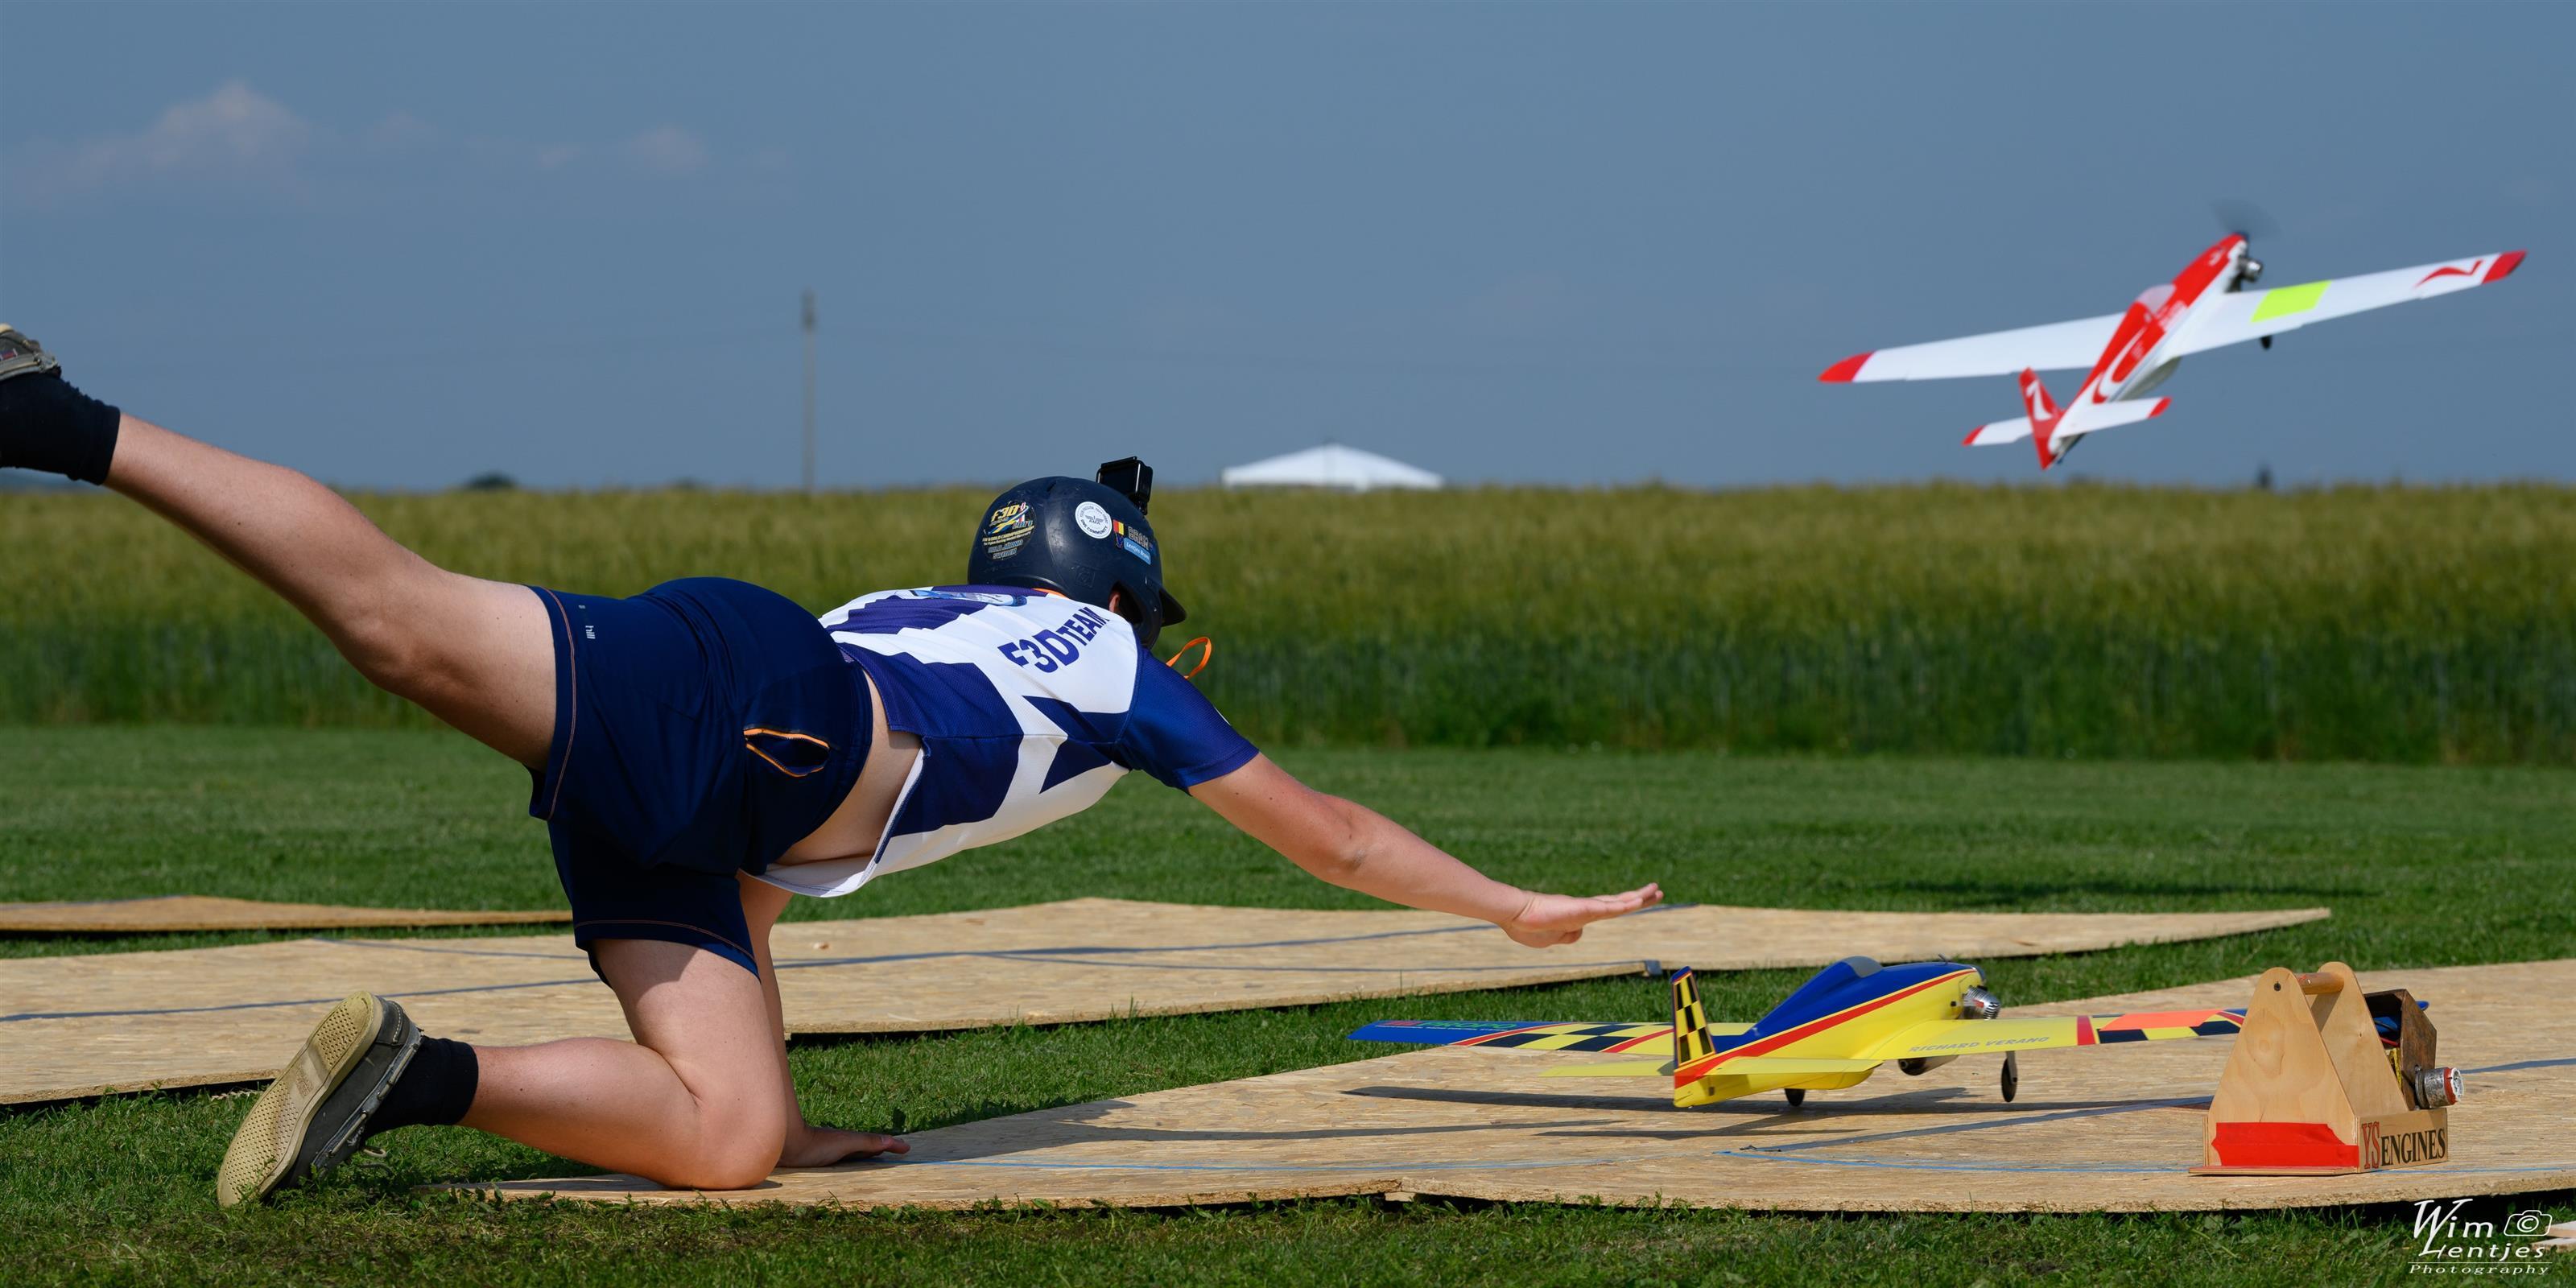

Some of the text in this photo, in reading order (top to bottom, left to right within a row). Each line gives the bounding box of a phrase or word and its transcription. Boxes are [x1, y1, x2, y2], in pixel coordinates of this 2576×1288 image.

[1087, 525, 1108, 535] COMMUNITY
[1909, 1036, 2050, 1052] RICHARD VERANO
